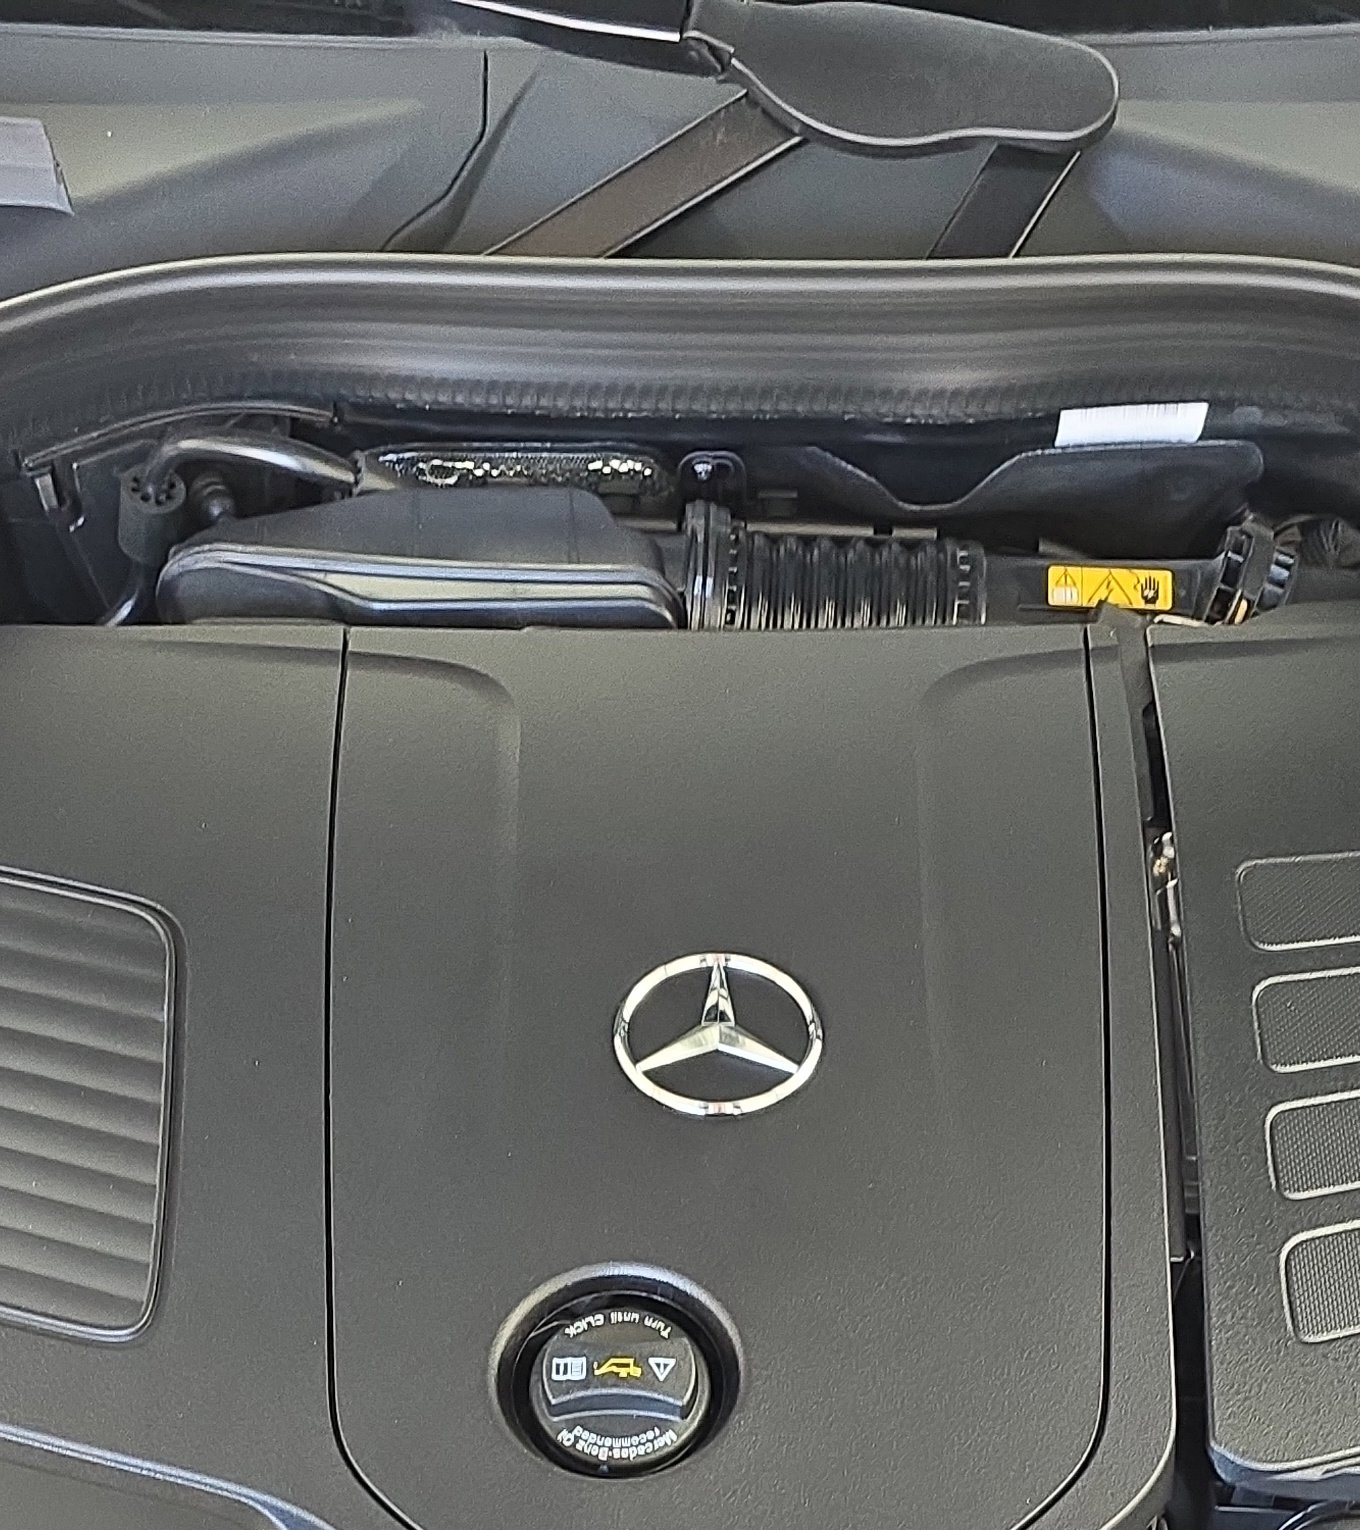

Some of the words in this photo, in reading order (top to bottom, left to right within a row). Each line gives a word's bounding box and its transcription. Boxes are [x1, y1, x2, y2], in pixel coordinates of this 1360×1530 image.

[564, 1313, 605, 1338] CLICK
[609, 1311, 640, 1324] until
[643, 1315, 672, 1339] Turn
[557, 1428, 575, 1447] Oil
[572, 1425, 660, 1447] recommended
